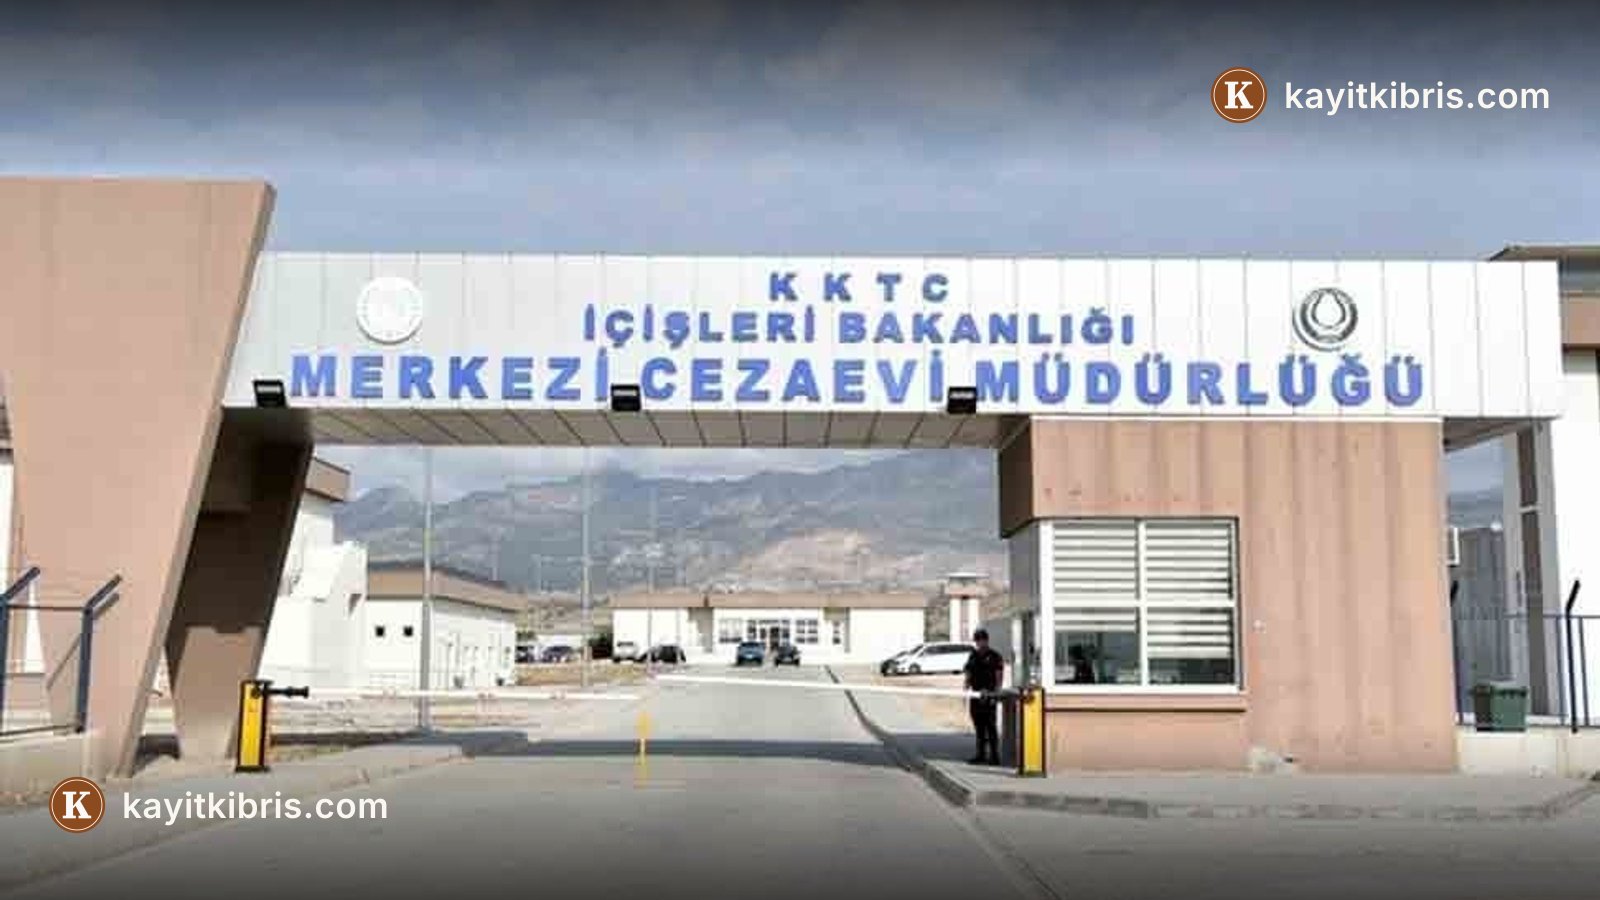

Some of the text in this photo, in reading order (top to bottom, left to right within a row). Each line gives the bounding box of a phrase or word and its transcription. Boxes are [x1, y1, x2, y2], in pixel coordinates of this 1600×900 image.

[584, 303, 1135, 348] İÇİŞLERİ BAKANLIĞI
[291, 348, 1424, 408] MERKEZİ CEZAEVİ MÜDÜRLÜĞÜ
